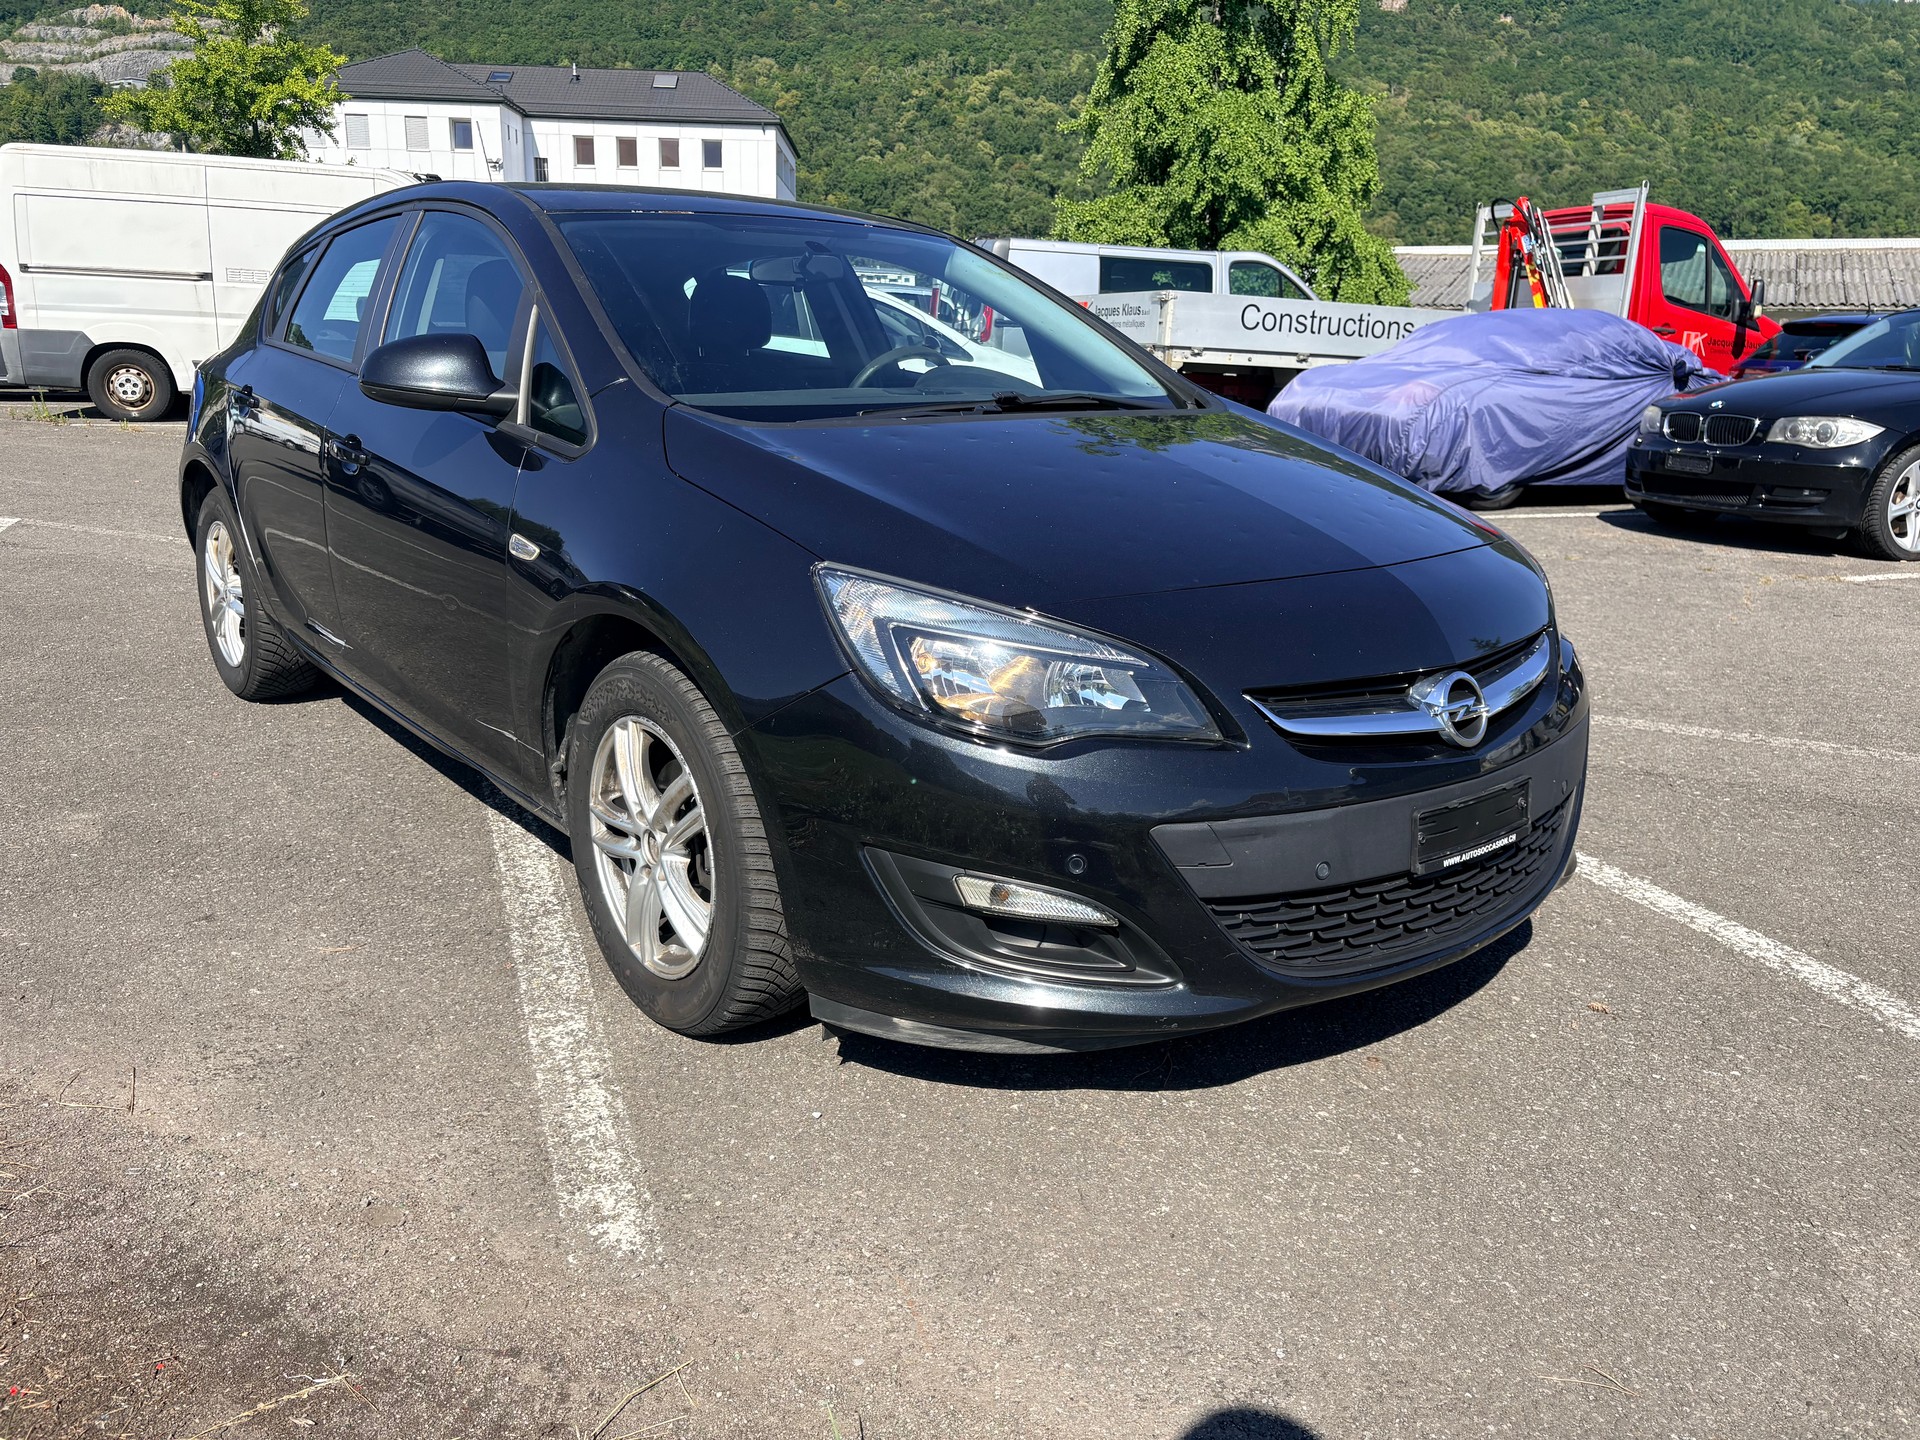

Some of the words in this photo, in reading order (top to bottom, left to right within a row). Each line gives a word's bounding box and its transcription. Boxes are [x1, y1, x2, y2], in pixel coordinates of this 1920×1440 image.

[1095, 304, 1120, 319] Jacques
[1122, 304, 1142, 316] Klaus
[1241, 303, 1416, 340] Constructions
[1443, 833, 1517, 868] WWW.AUTOSOCCASION.CH
